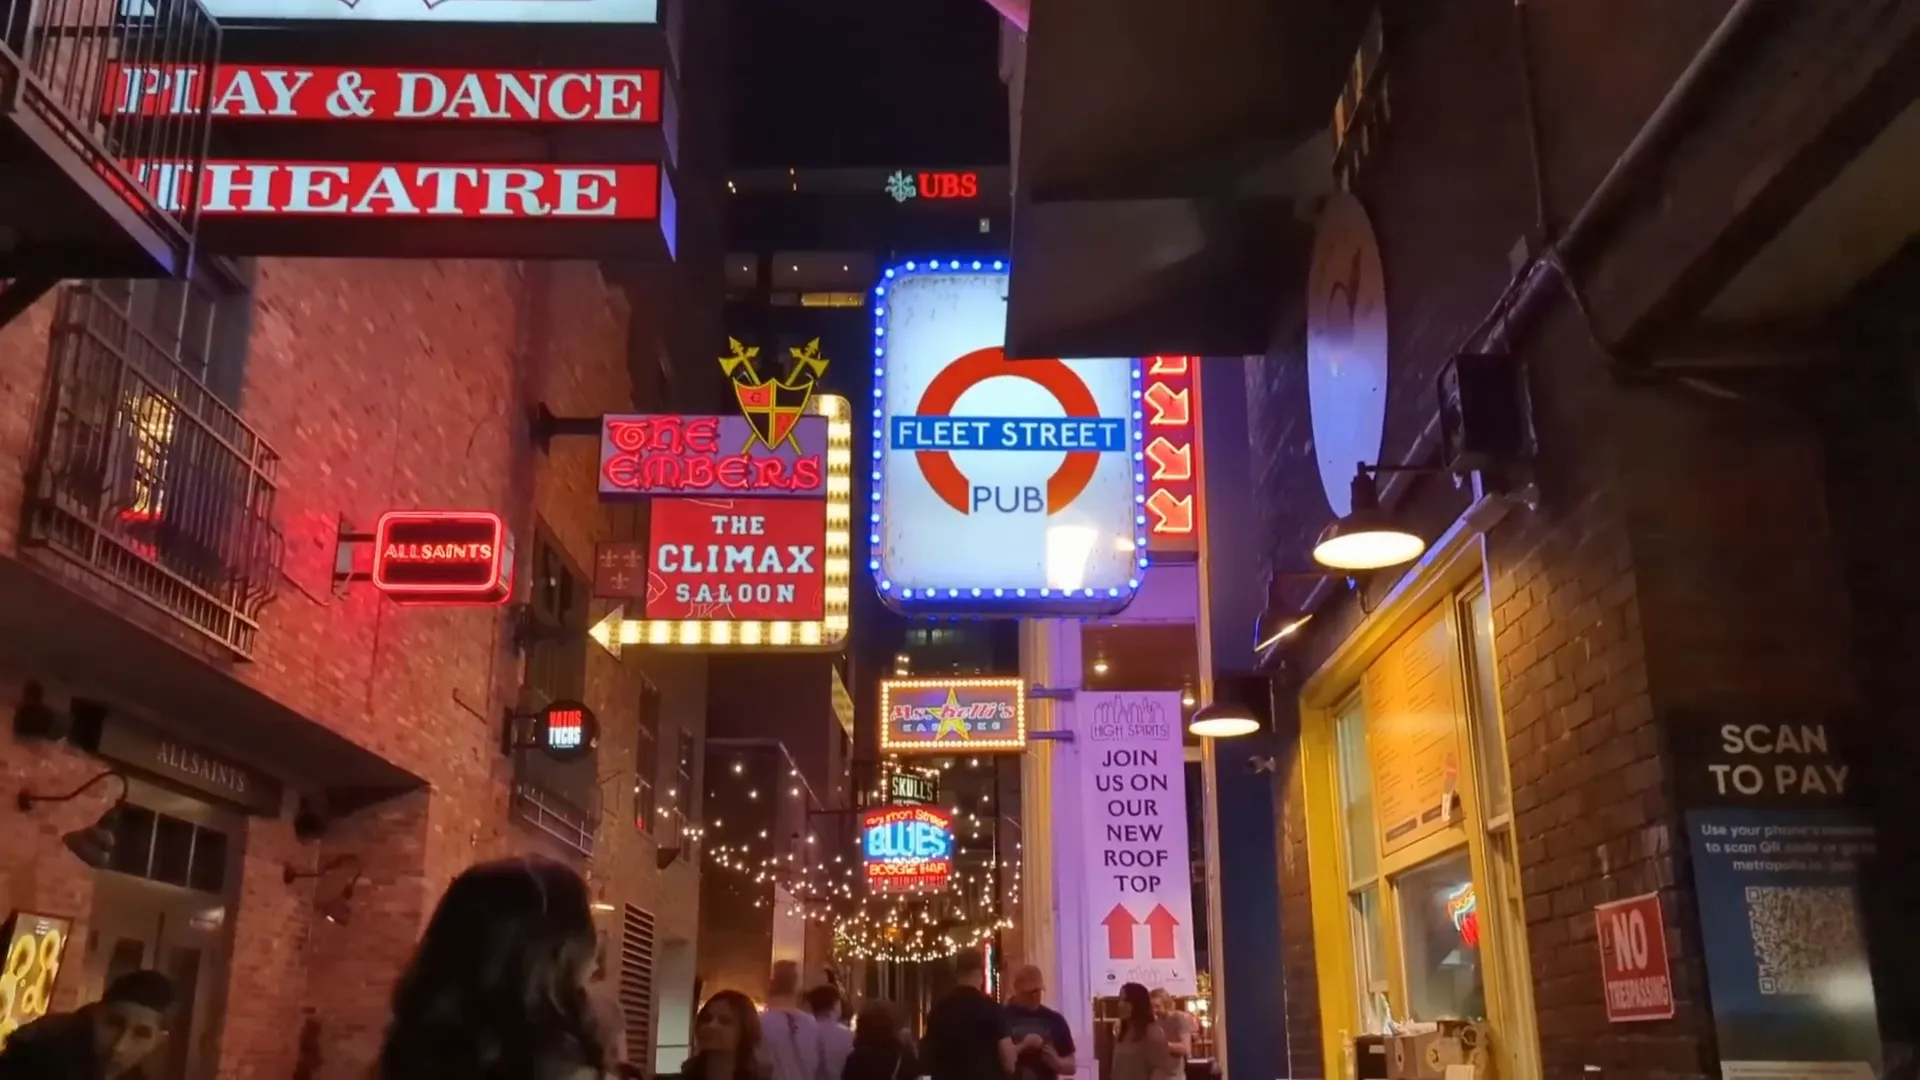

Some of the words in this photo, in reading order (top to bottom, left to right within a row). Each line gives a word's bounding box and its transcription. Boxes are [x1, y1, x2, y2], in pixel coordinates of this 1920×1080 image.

[117, 68, 314, 115] PLAY
[325, 70, 376, 118] &
[393, 72, 642, 120] DANCE
[138, 163, 617, 215] THEATRE
[918, 172, 977, 198] UBS
[606, 415, 720, 454] THE
[898, 421, 991, 446] FLEET
[1001, 422, 1118, 447] STREET
[604, 451, 822, 493] EMBERS
[972, 485, 1044, 513] PUB
[711, 515, 765, 535] THE
[384, 543, 493, 560] ALLSAINTS
[658, 544, 815, 574] CLIMAX
[676, 583, 795, 604] SALOON
[1721, 724, 1829, 754] SCAN
[157, 741, 246, 793] ALLSAINTS
[1102, 749, 1158, 767] JOIN
[892, 776, 934, 801] SKULL'S
[1095, 774, 1124, 792] US
[1130, 774, 1168, 791] ON
[1708, 764, 1763, 795] TO
[1774, 764, 1849, 795] PAY
[1107, 799, 1158, 817] OUR
[868, 820, 947, 857] BLUES
[1106, 824, 1163, 842] NEW
[1701, 824, 1727, 836] Use
[1730, 825, 1761, 839] your
[1104, 849, 1168, 867] ROOF
[1705, 841, 1721, 853] to
[1724, 842, 1757, 854] scan
[1113, 875, 1161, 893] TOP
[1611, 908, 1648, 972] NO
